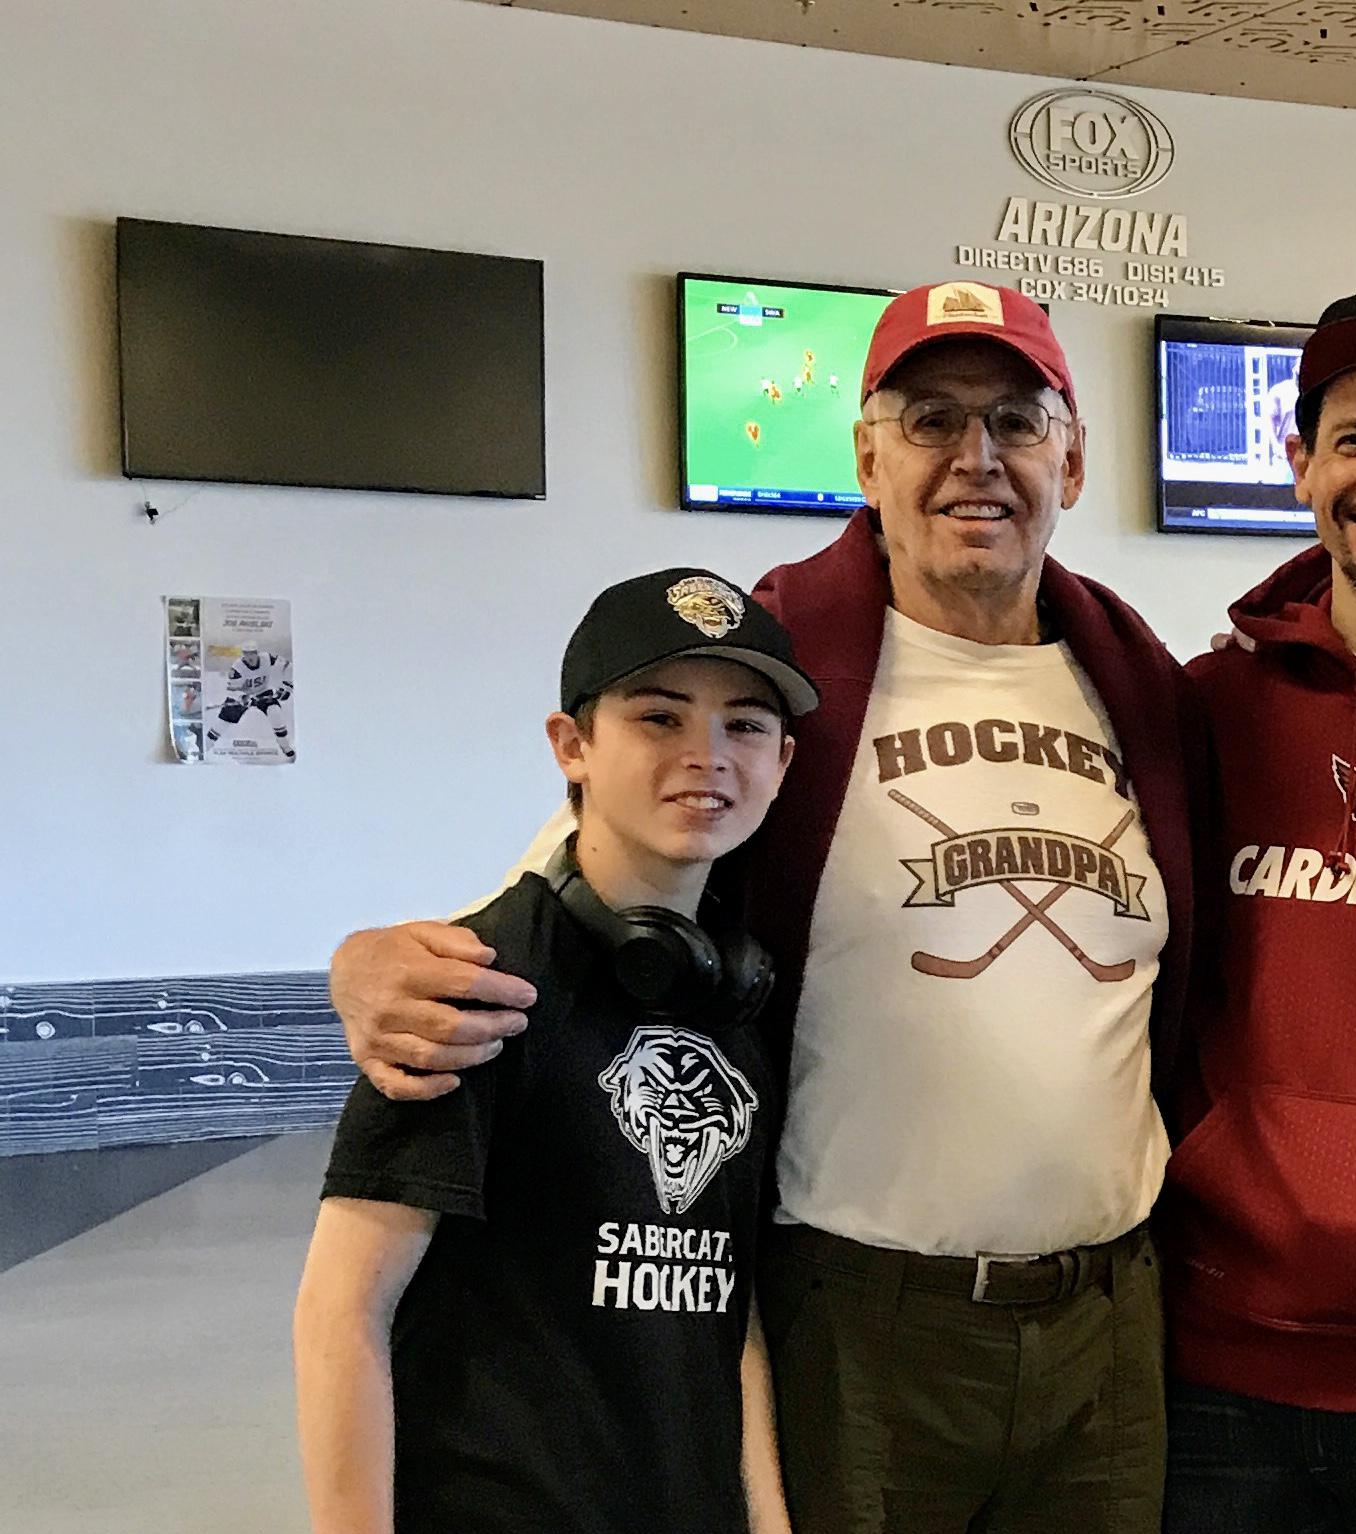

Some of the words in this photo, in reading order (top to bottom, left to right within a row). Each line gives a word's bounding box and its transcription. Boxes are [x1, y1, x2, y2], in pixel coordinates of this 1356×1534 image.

[1048, 106, 1140, 160] FOX
[1047, 153, 1142, 179] SPORTS
[995, 196, 1188, 258] ARIZONA
[957, 245, 1052, 273] DIRECTV
[1057, 258, 1104, 278] 686
[1126, 261, 1180, 285] DISH
[1184, 266, 1226, 287] 415
[1019, 277, 1067, 300] COX
[1072, 281, 1170, 308] 34/1034
[873, 719, 1131, 800] HOCKEY
[943, 836, 1123, 899] GRANDPA
[591, 1260, 736, 1313] HOCKEY
